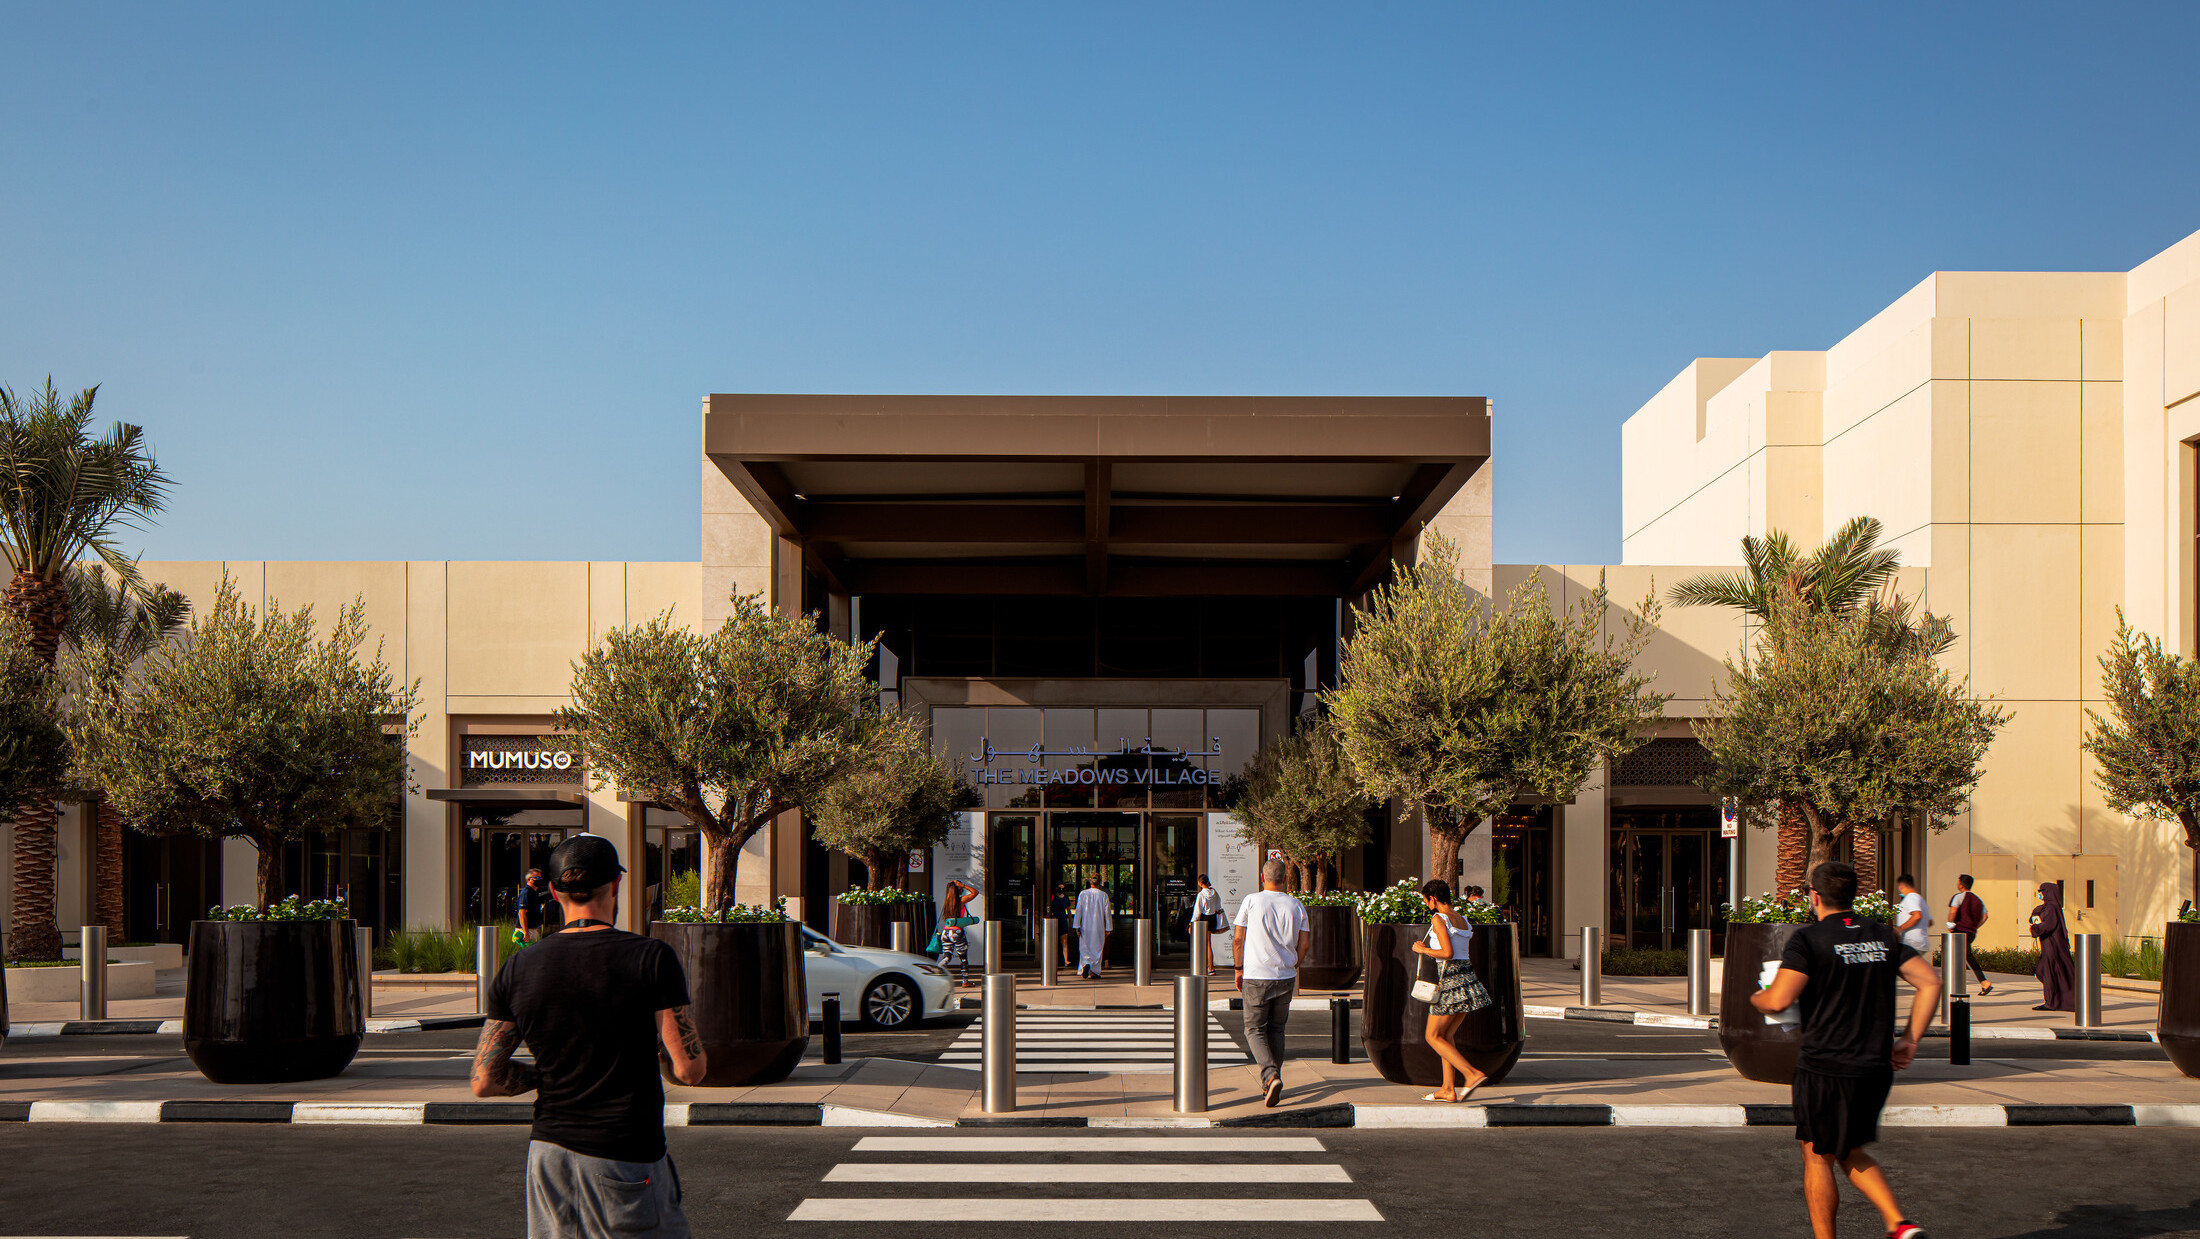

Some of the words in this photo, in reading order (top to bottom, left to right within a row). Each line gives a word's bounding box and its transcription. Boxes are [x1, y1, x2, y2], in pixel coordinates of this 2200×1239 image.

[970, 736, 1130, 763] السهول
[1140, 736, 1221, 762] قرية
[470, 751, 572, 770] MUMUSO
[971, 768, 1013, 784] THE
[1018, 768, 1129, 785] MEADOWS
[1134, 768, 1221, 785] VILLAGE
